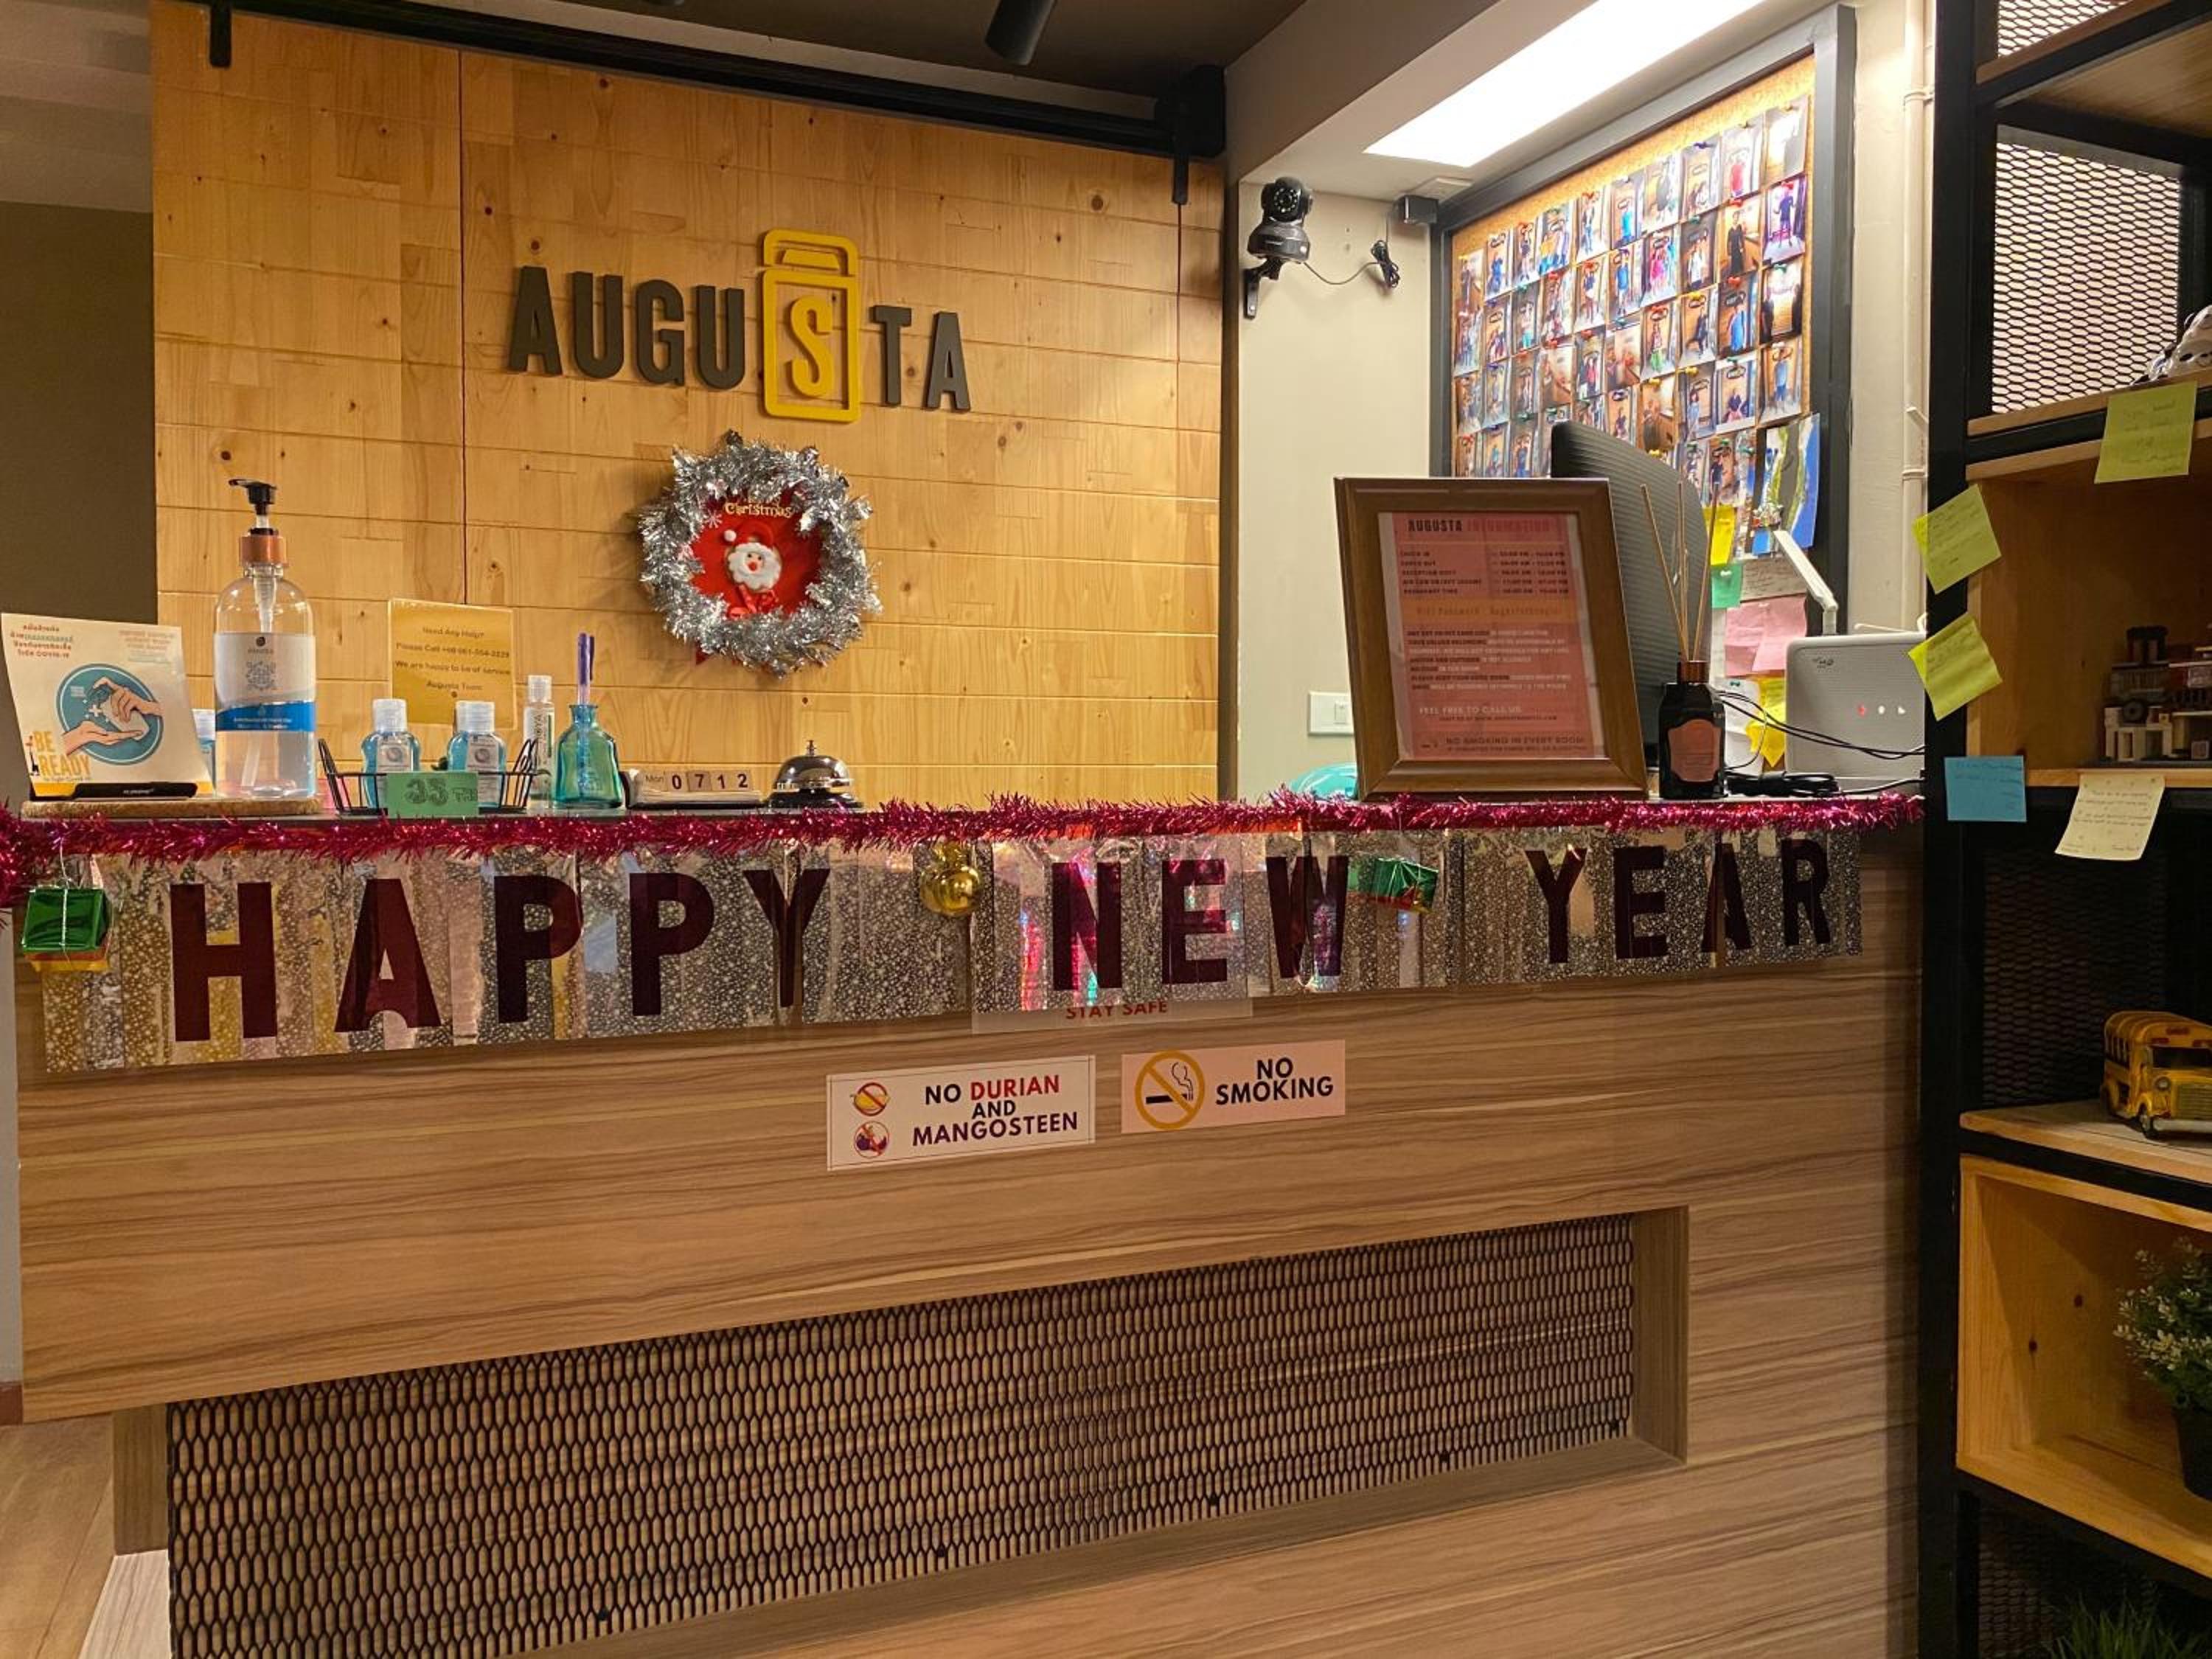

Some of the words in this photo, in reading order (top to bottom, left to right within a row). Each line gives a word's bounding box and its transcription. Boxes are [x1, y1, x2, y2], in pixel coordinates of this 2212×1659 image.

[507, 265, 971, 413] AUGUSTA
[724, 502, 793, 518] Christmas
[1408, 519, 1463, 532] AUGUSTA
[35, 731, 55, 752] BE
[38, 754, 91, 776] READY
[170, 868, 831, 1041] HAPPY
[1052, 855, 1349, 990] NEW
[1524, 838, 1832, 964] YEAR
[1066, 1006, 1115, 1020] STAY
[1121, 1001, 1169, 1016] SAFE
[1257, 1057, 1293, 1080] NO
[925, 1084, 961, 1105] NO
[970, 1074, 1060, 1101] DURIAN
[1216, 1076, 1334, 1105] SMOKING
[971, 1099, 1016, 1119] AND
[912, 1111, 1078, 1147] MANGOSTEEN
